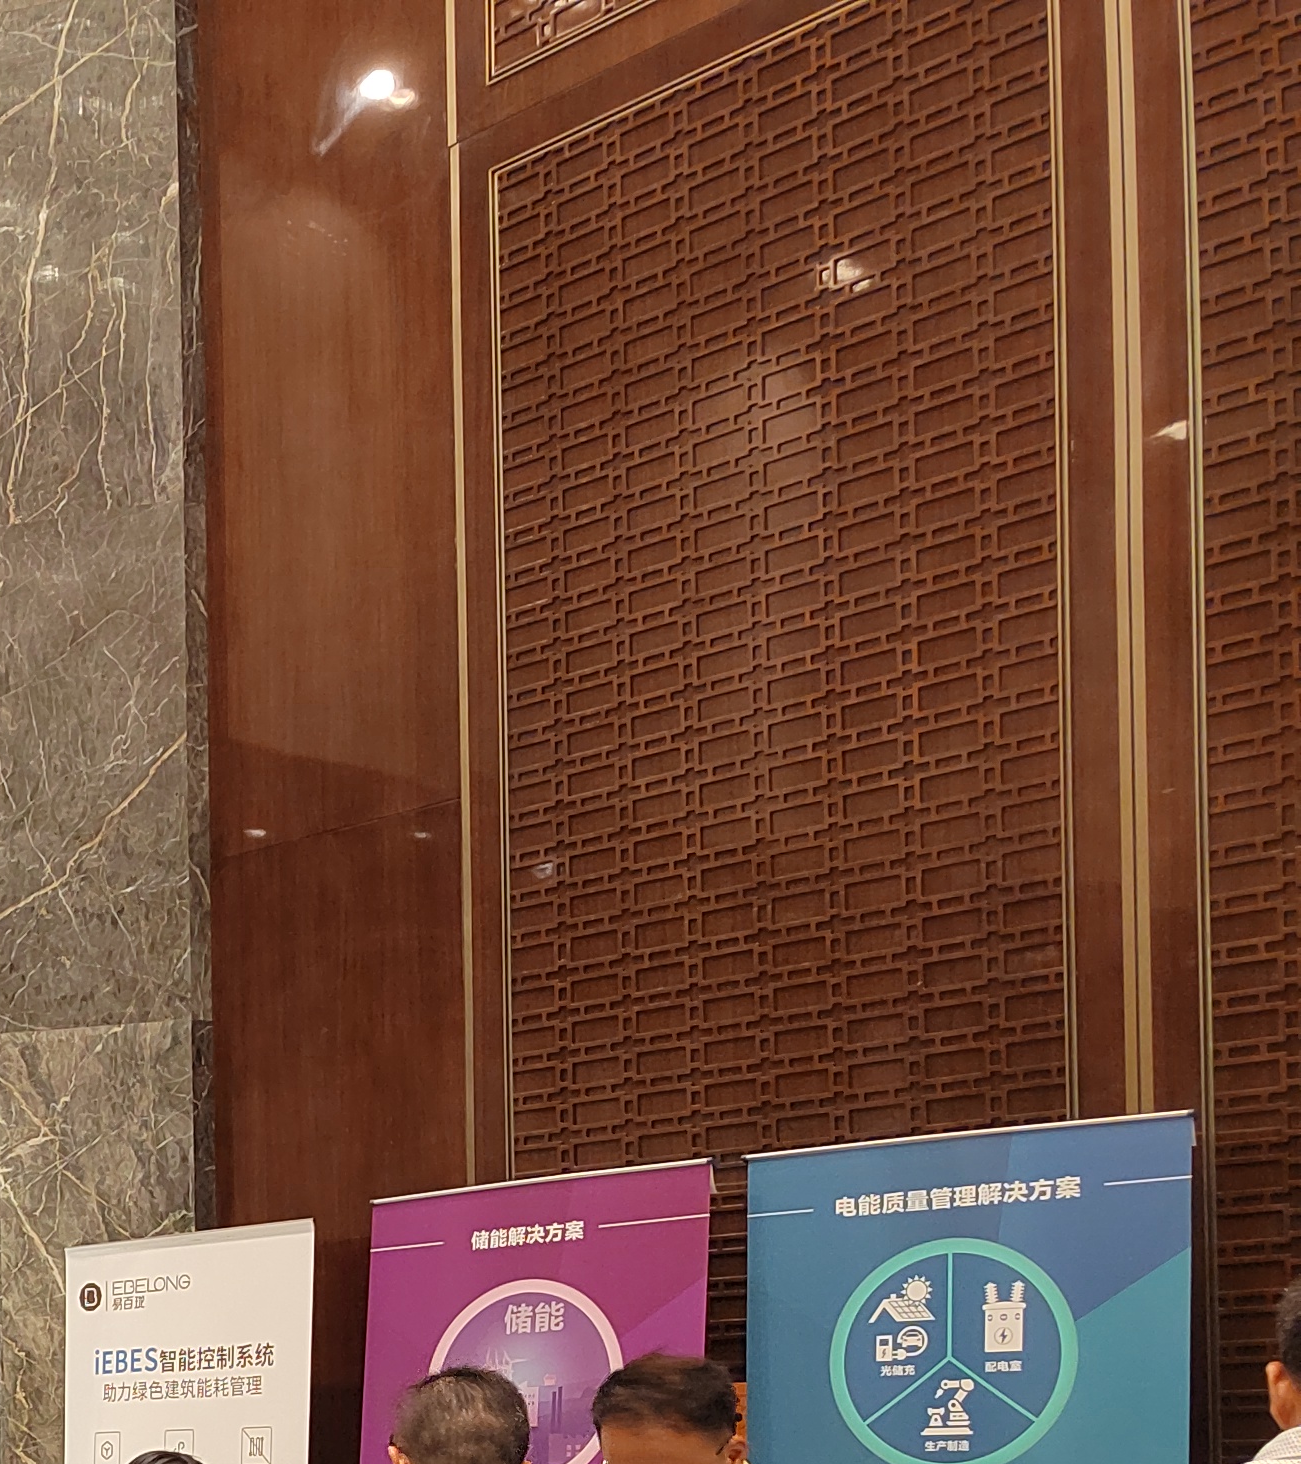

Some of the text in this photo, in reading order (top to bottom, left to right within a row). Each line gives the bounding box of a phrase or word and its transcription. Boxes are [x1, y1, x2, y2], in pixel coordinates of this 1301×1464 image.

[834, 1175, 1081, 1217] 电能质量管理解决方案
[471, 1220, 584, 1251] 储能解决方案
[504, 1301, 565, 1335] 储能
[94, 1342, 275, 1375] iEBES智能控制系统
[880, 1364, 916, 1377] 光储充
[985, 1360, 1022, 1372] 配电室
[103, 1375, 262, 1402] 助力绿色建筑能耗管理
[924, 1440, 970, 1452] 生产制造
